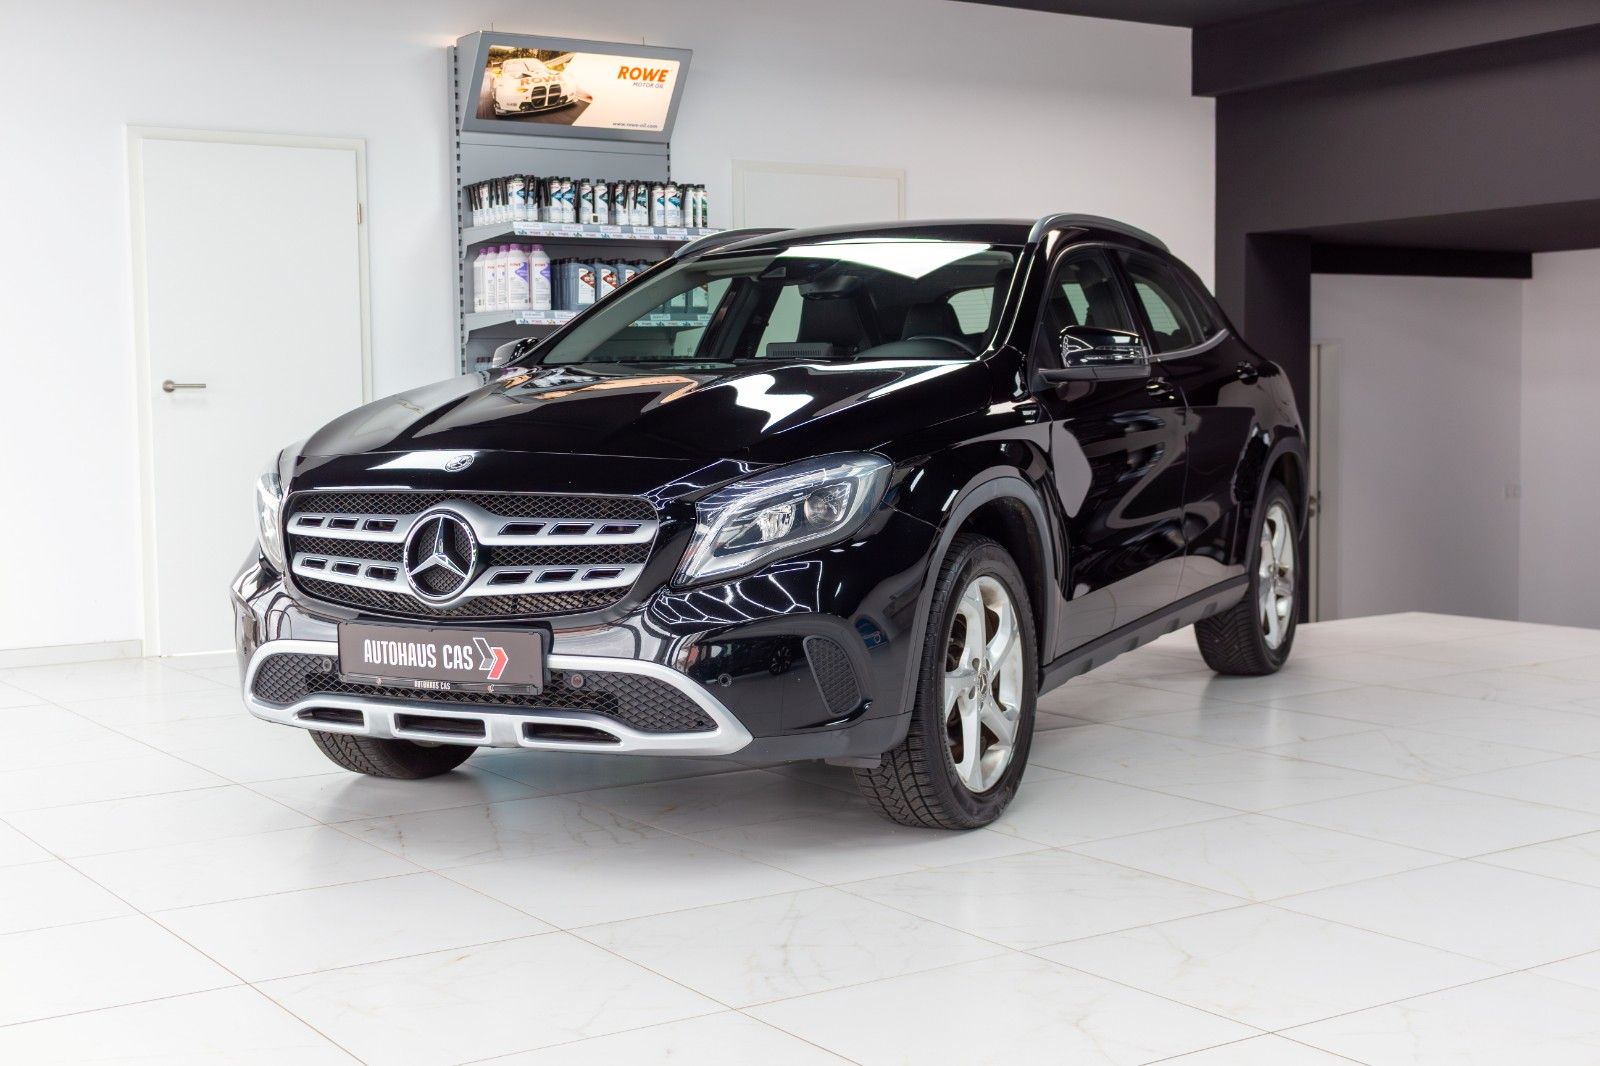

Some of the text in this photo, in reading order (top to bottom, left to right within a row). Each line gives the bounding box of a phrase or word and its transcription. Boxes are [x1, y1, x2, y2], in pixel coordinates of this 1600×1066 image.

[618, 66, 669, 83] ROWE
[364, 639, 474, 670] AUTOHAUS CAS
[440, 682, 451, 690] CAS
